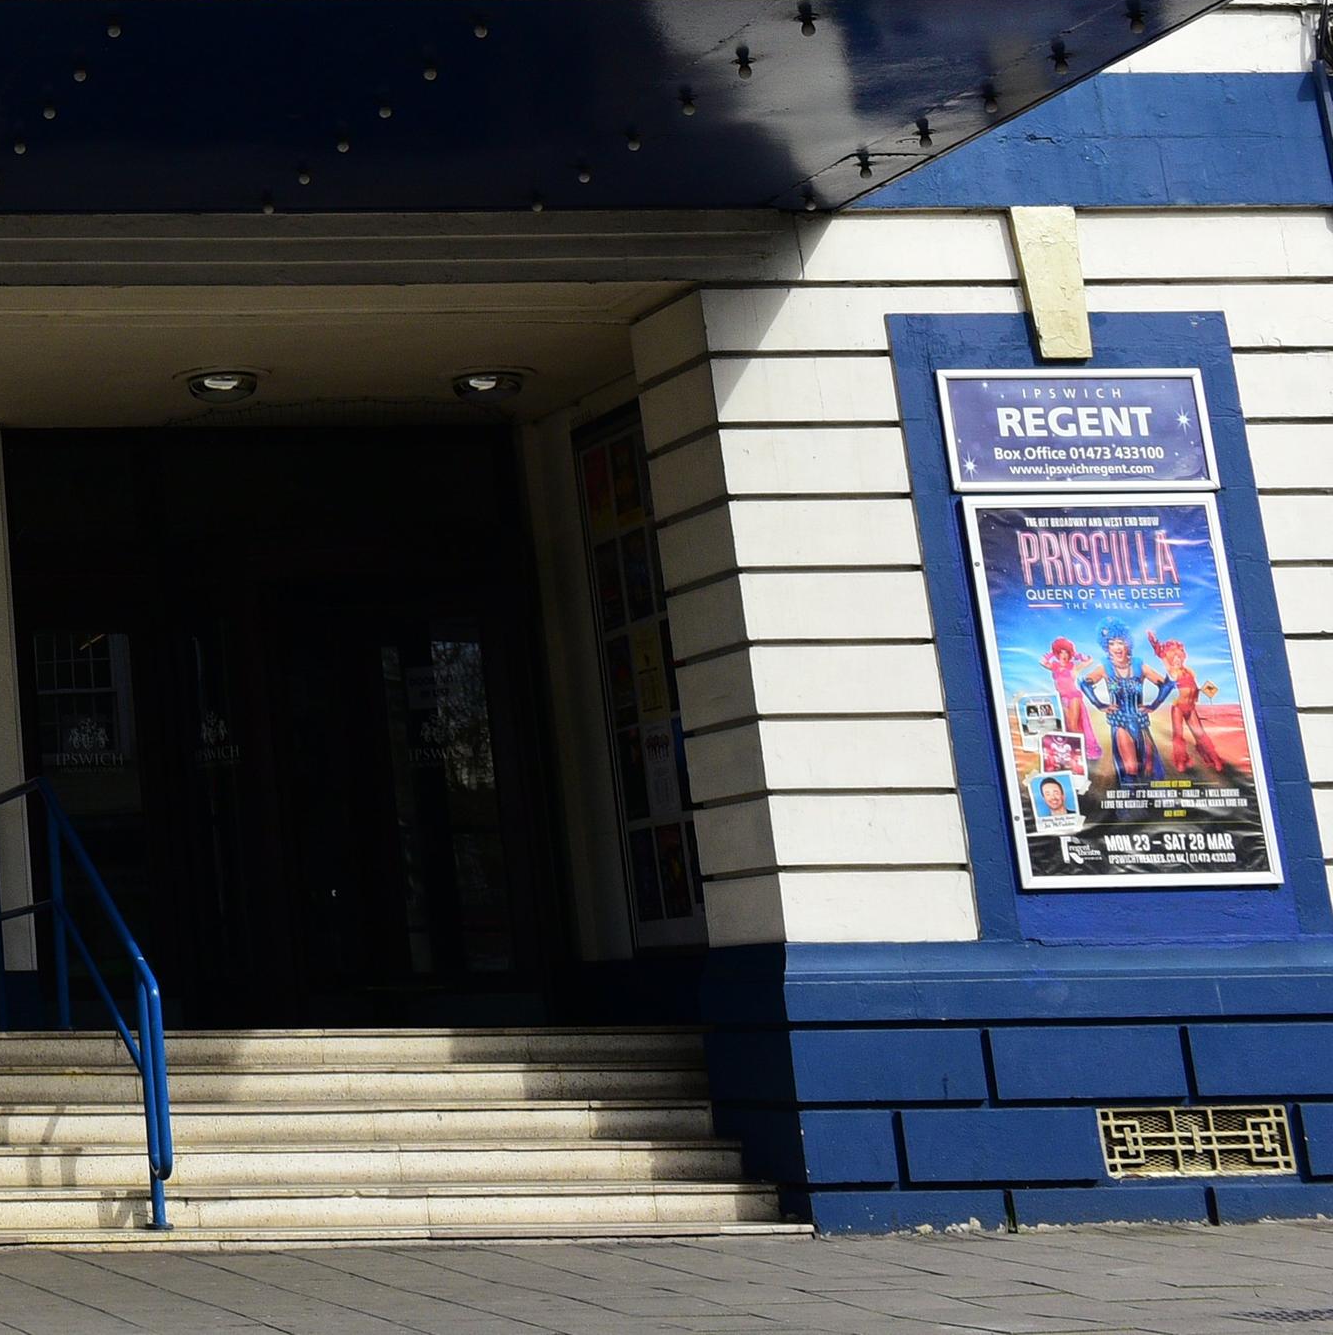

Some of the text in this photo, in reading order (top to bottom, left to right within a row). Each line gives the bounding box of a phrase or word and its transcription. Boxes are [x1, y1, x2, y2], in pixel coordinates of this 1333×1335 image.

[1022, 388, 1122, 399] IPSWICH
[996, 406, 1153, 438] REGENT
[994, 446, 1165, 461] Box Office 01473 433100
[1009, 464, 1155, 476] www.ipswichregent.com
[1017, 529, 1181, 586] PRISCILLA
[1025, 587, 1182, 601] QUEEN OF THE DESERT
[55, 753, 124, 766] IPSWICH
[1104, 834, 1133, 852] MON
[1134, 833, 1151, 851] 23
[1163, 833, 1187, 851] SAT
[1189, 833, 1205, 850] 28
[1206, 832, 1235, 850] MAR
